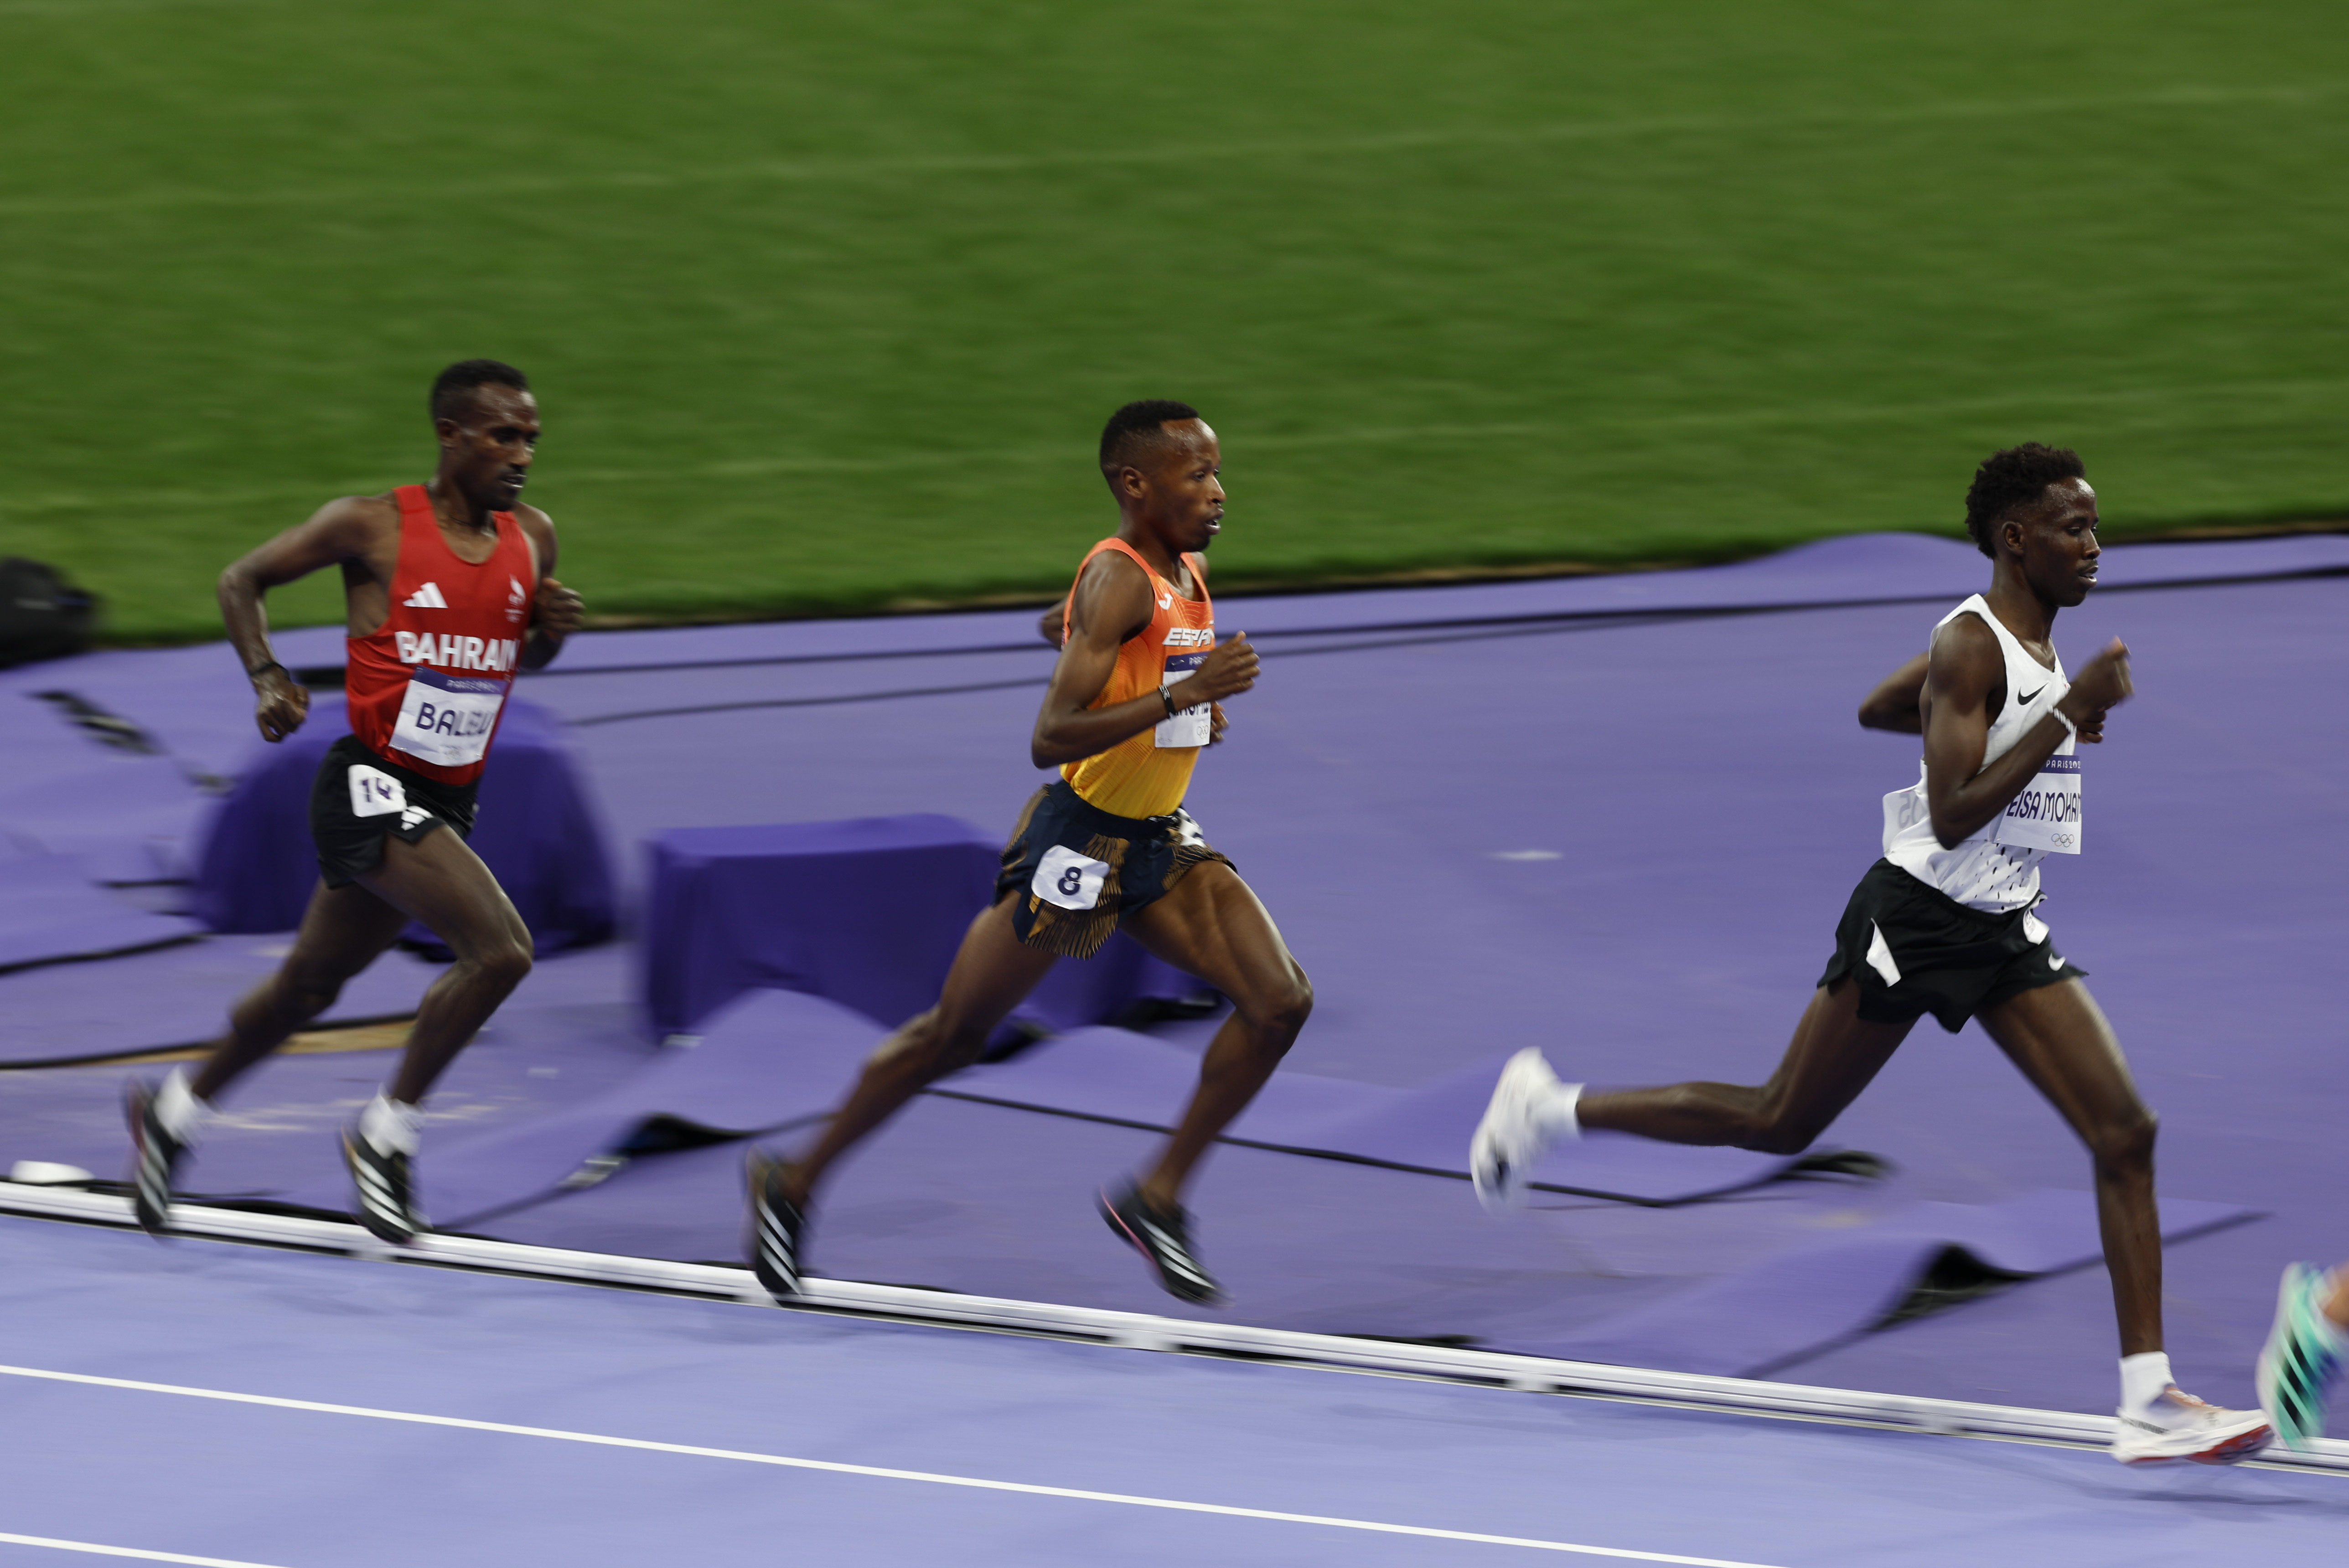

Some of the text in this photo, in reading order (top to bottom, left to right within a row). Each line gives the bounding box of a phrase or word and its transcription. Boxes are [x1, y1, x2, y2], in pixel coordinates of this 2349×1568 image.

[395, 631, 520, 672] BAHRAIN
[2006, 790, 2041, 820] EISA
[1058, 867, 1082, 896] 8
